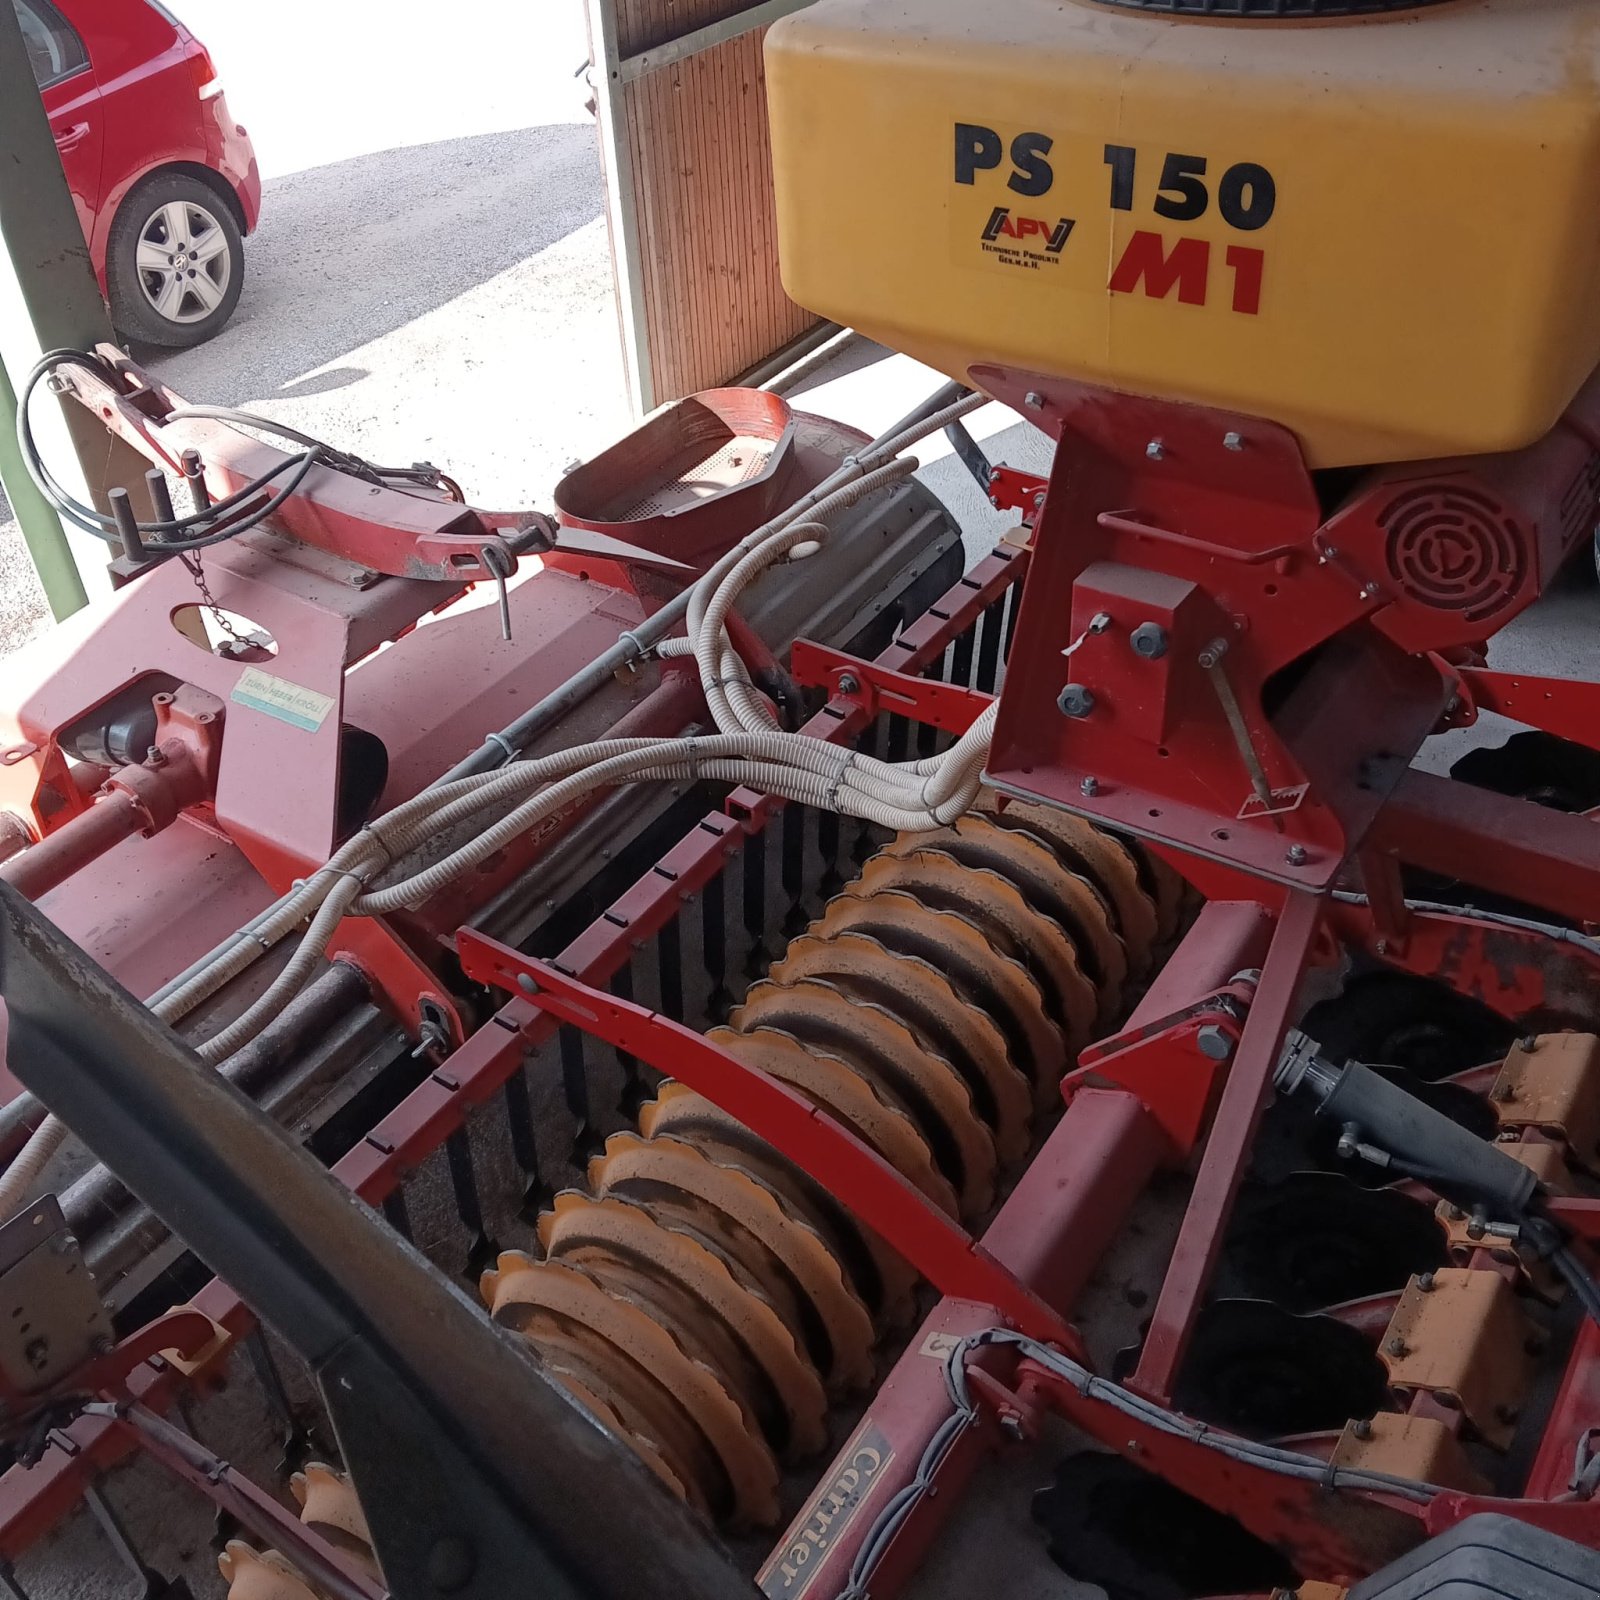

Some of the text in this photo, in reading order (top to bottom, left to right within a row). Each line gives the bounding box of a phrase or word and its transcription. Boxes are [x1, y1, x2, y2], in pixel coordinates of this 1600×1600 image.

[954, 122, 1276, 231] PS 150
[991, 211, 1065, 249] APV
[1107, 230, 1265, 316] M1
[778, 1447, 881, 1588] Carrier
